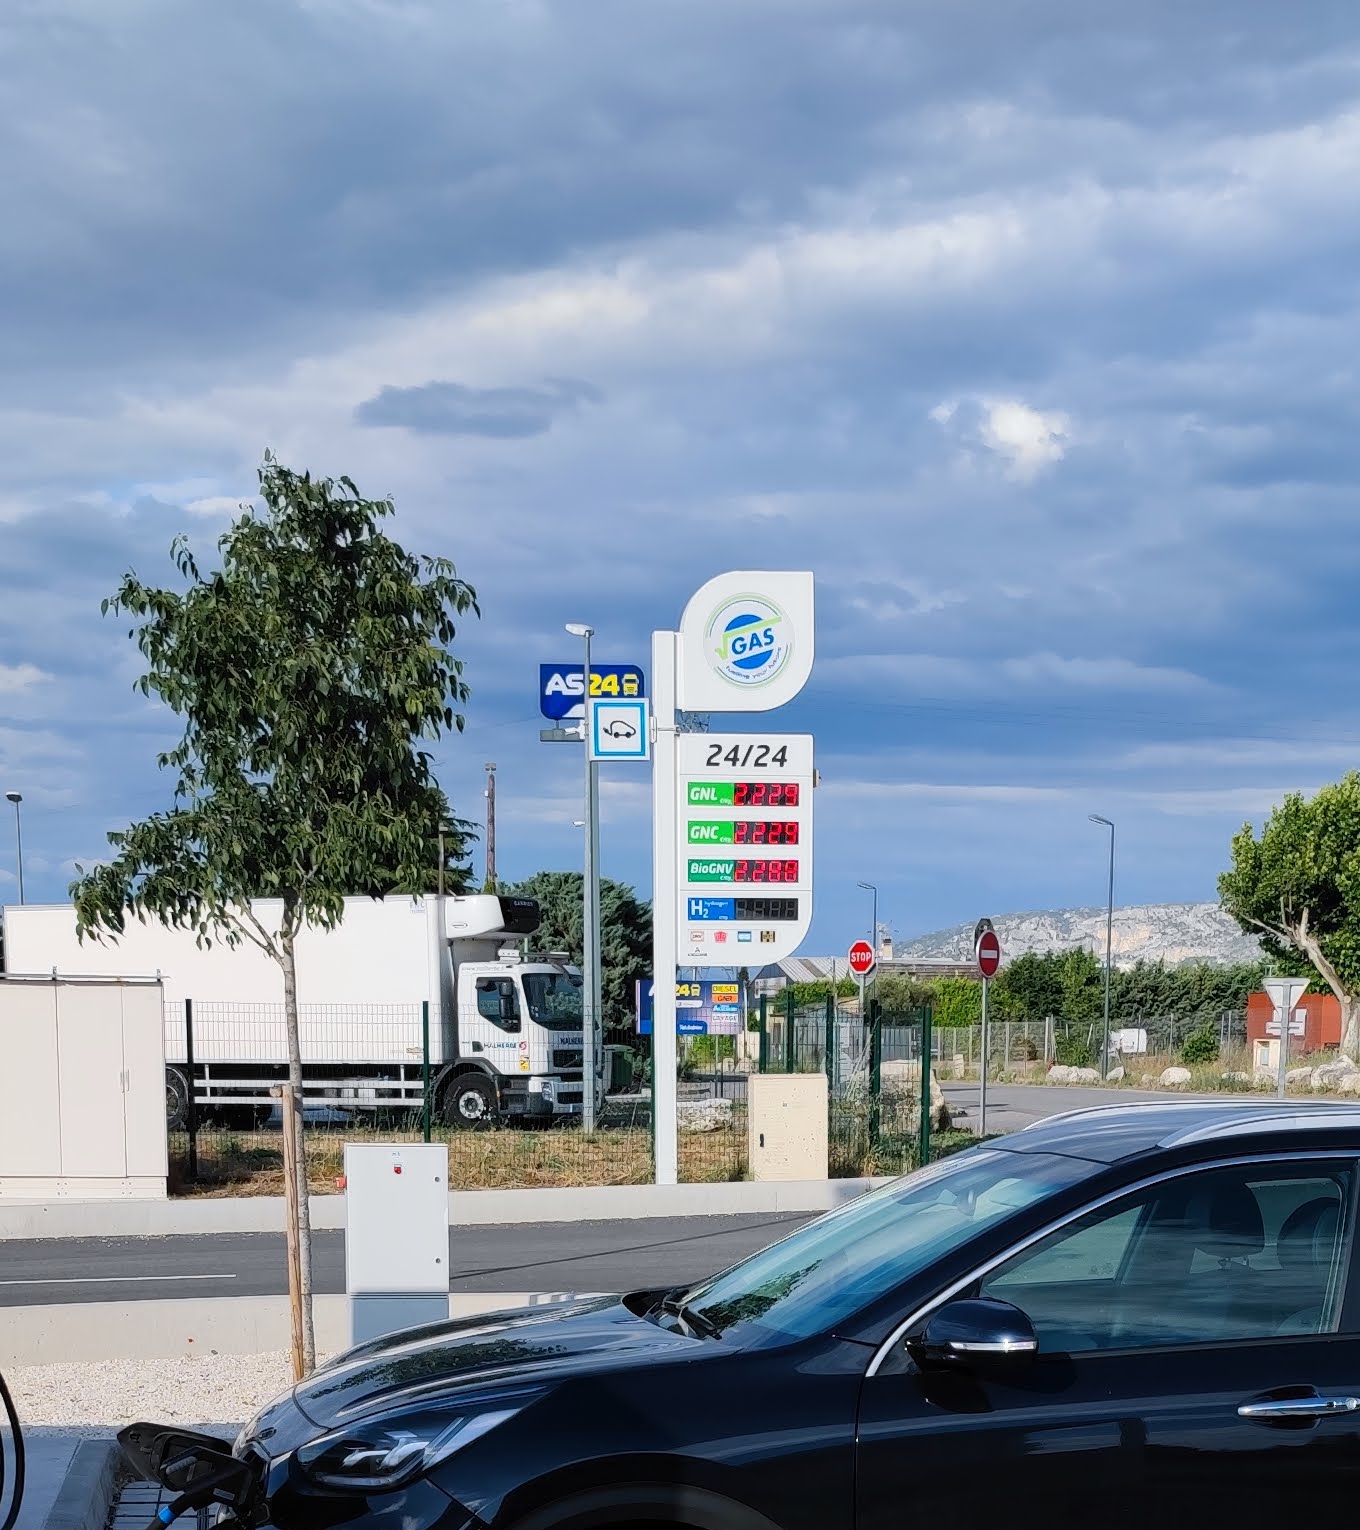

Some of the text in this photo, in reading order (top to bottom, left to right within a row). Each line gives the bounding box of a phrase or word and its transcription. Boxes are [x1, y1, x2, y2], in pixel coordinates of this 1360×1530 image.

[732, 628, 774, 655] GAS
[706, 744, 787, 767] 24/24
[690, 787, 717, 801] GNL
[690, 826, 719, 840] GNC
[690, 863, 734, 874] BioGNV
[851, 952, 872, 963] STOP
